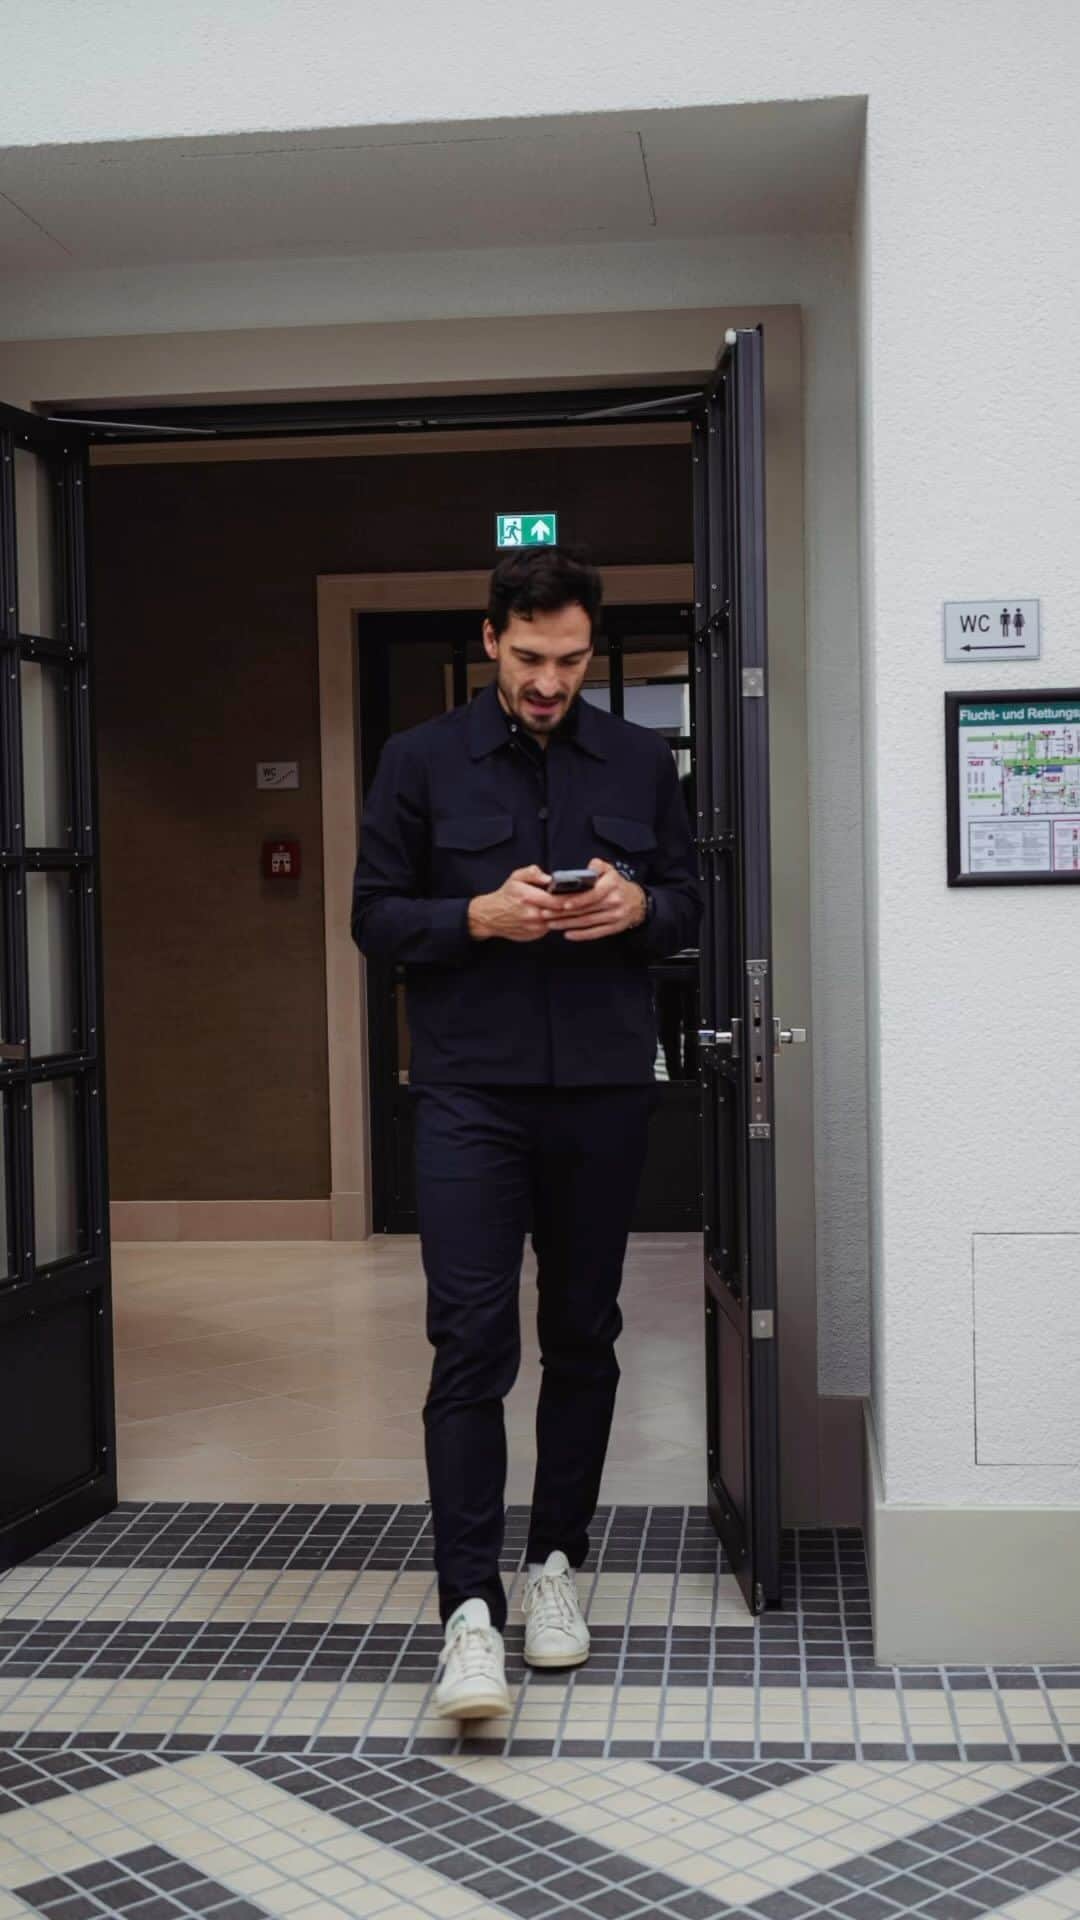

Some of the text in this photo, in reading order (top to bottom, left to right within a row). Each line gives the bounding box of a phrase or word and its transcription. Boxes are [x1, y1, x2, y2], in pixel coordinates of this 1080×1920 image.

[960, 614, 991, 633] WC
[960, 709, 1000, 721] Flucht-
[1002, 708, 1025, 720] und
[263, 767, 277, 777] WC
